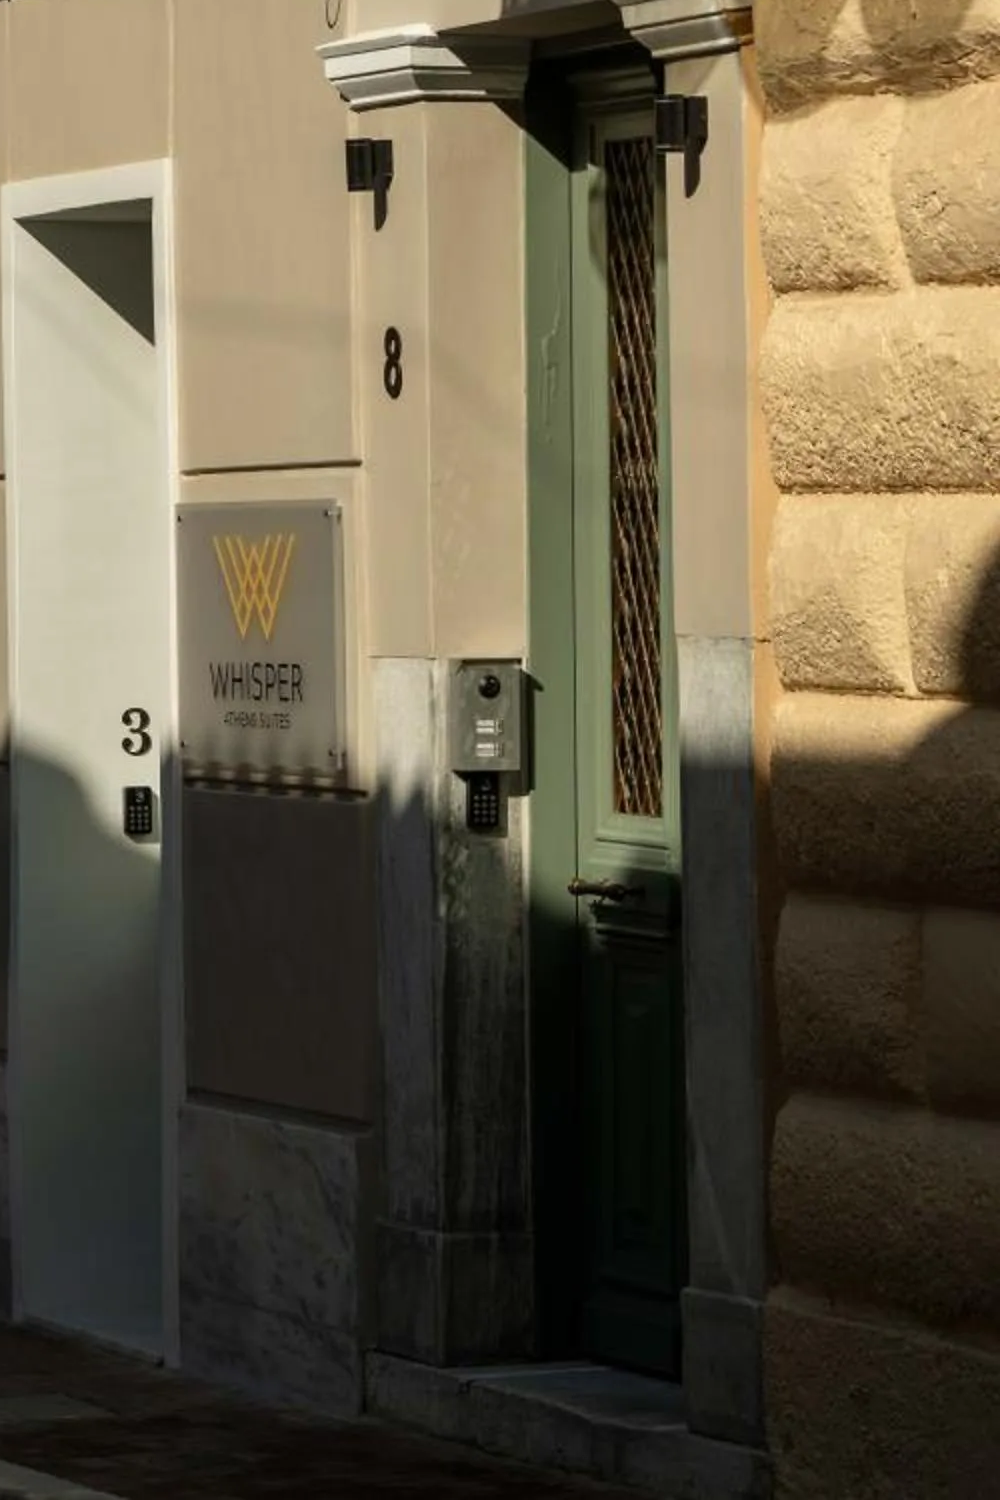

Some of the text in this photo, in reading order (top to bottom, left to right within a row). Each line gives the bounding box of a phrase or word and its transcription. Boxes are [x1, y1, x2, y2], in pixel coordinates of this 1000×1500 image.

[383, 326, 403, 399] 8
[209, 662, 303, 703] WHISPER
[121, 707, 152, 756] 3
